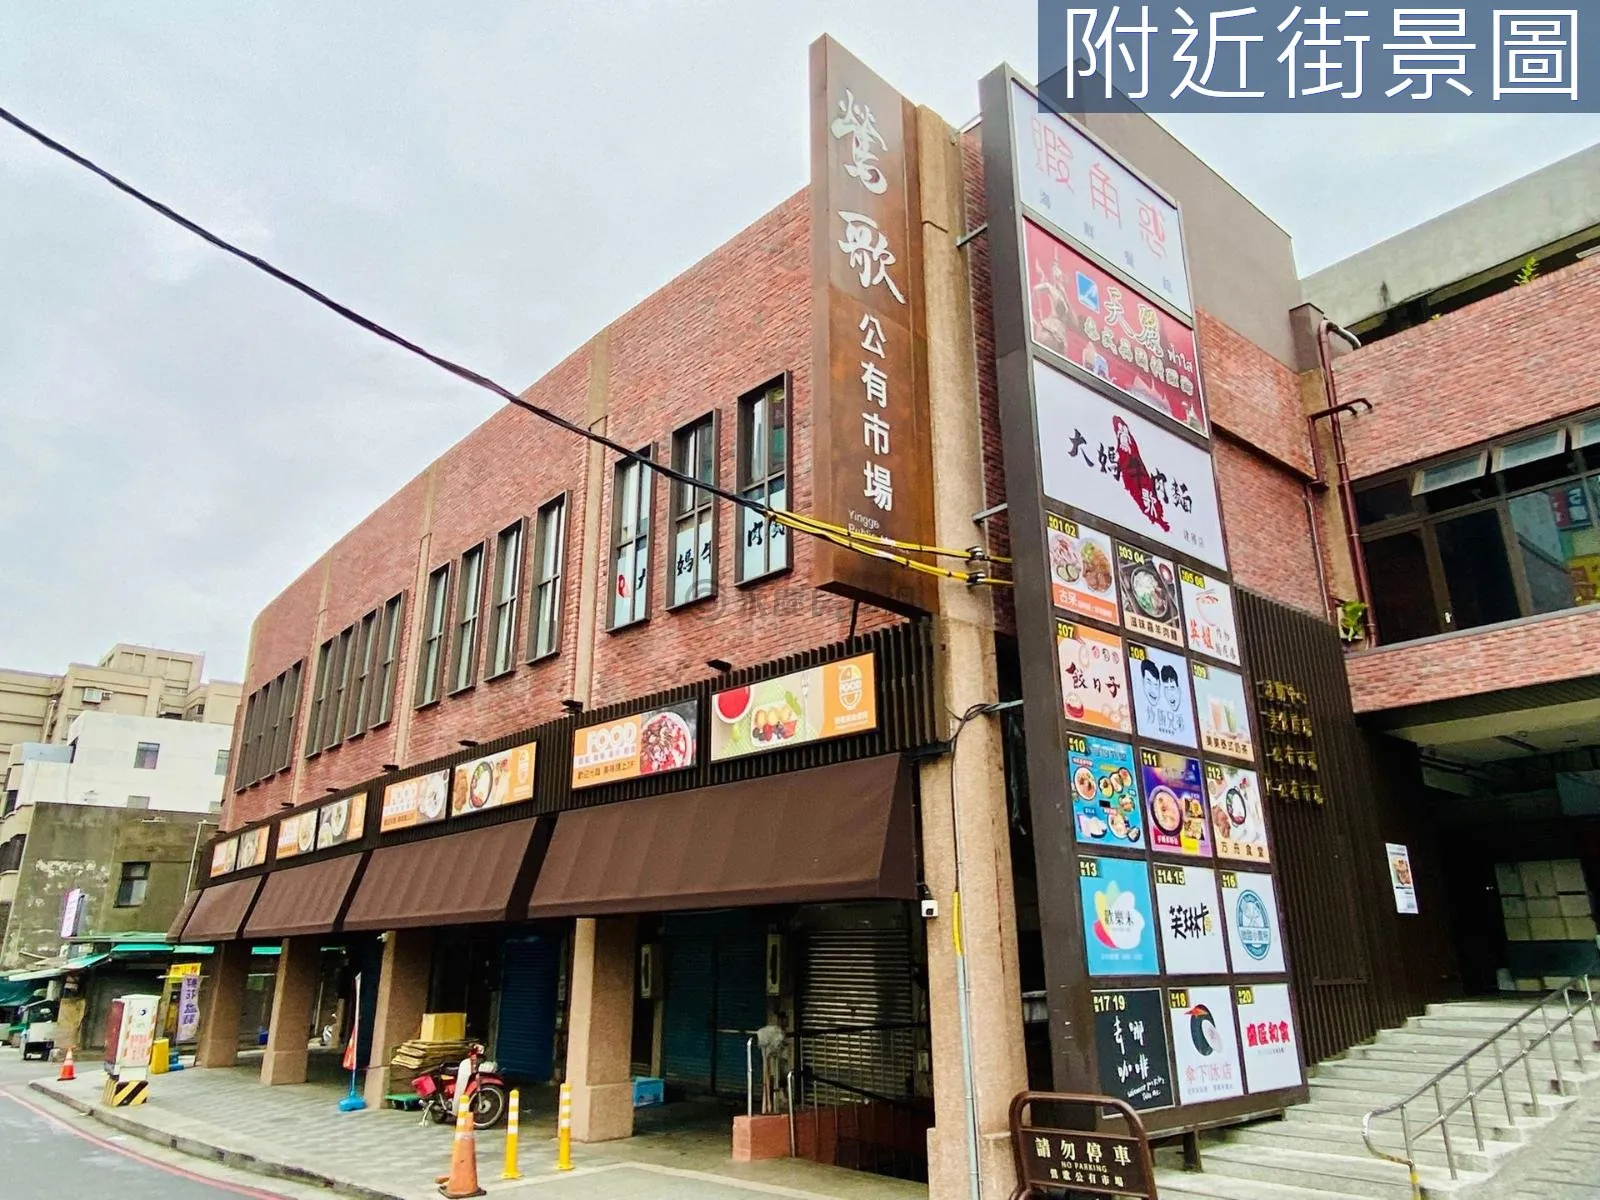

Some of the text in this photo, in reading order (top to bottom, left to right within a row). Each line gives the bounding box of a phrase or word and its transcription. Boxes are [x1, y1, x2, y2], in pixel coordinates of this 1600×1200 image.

[1053, 518, 1076, 537] 01 02
[1122, 547, 1145, 564] 03 04
[1062, 625, 1074, 639] 07
[1074, 738, 1086, 752] 10
[1147, 752, 1158, 766] 11
[1086, 861, 1097, 877] 13
[1161, 869, 1185, 885] 14 15
[1099, 995, 1125, 1011] 17 19
[1175, 994, 1187, 1007] 18
[1241, 989, 1252, 1003] 20
[1034, 1137, 1132, 1167] 請勿停車
[1061, 1160, 1108, 1174] NO PARKING
